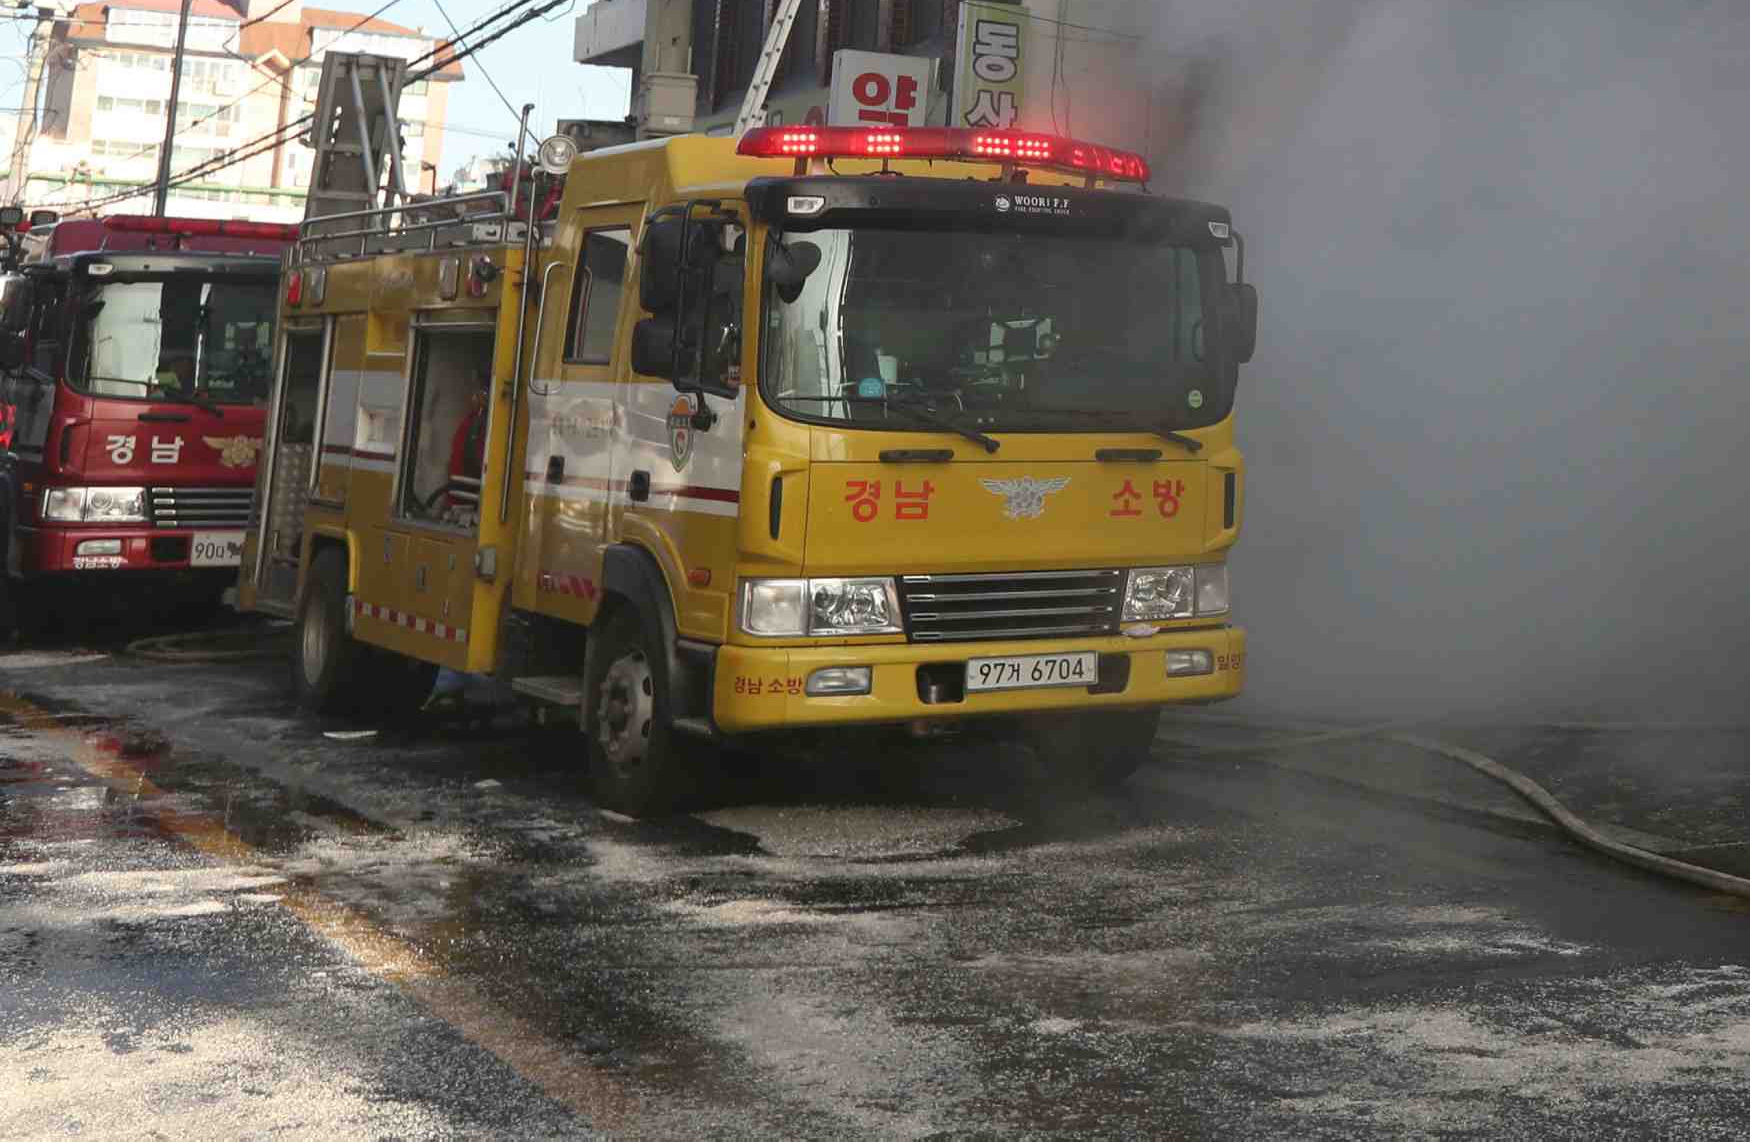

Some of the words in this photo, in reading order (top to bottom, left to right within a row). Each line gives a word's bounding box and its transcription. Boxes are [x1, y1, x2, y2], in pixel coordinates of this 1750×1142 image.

[852, 72, 918, 127] 약
[1014, 195, 1051, 207] WOORI
[105, 434, 185, 465] 경남
[845, 479, 935, 522] 경남
[1109, 479, 1185, 519] 소방
[735, 676, 763, 695] 경남
[767, 676, 803, 695] 소방
[978, 662, 1021, 686] 97거
[1030, 657, 1085, 682] 6704
